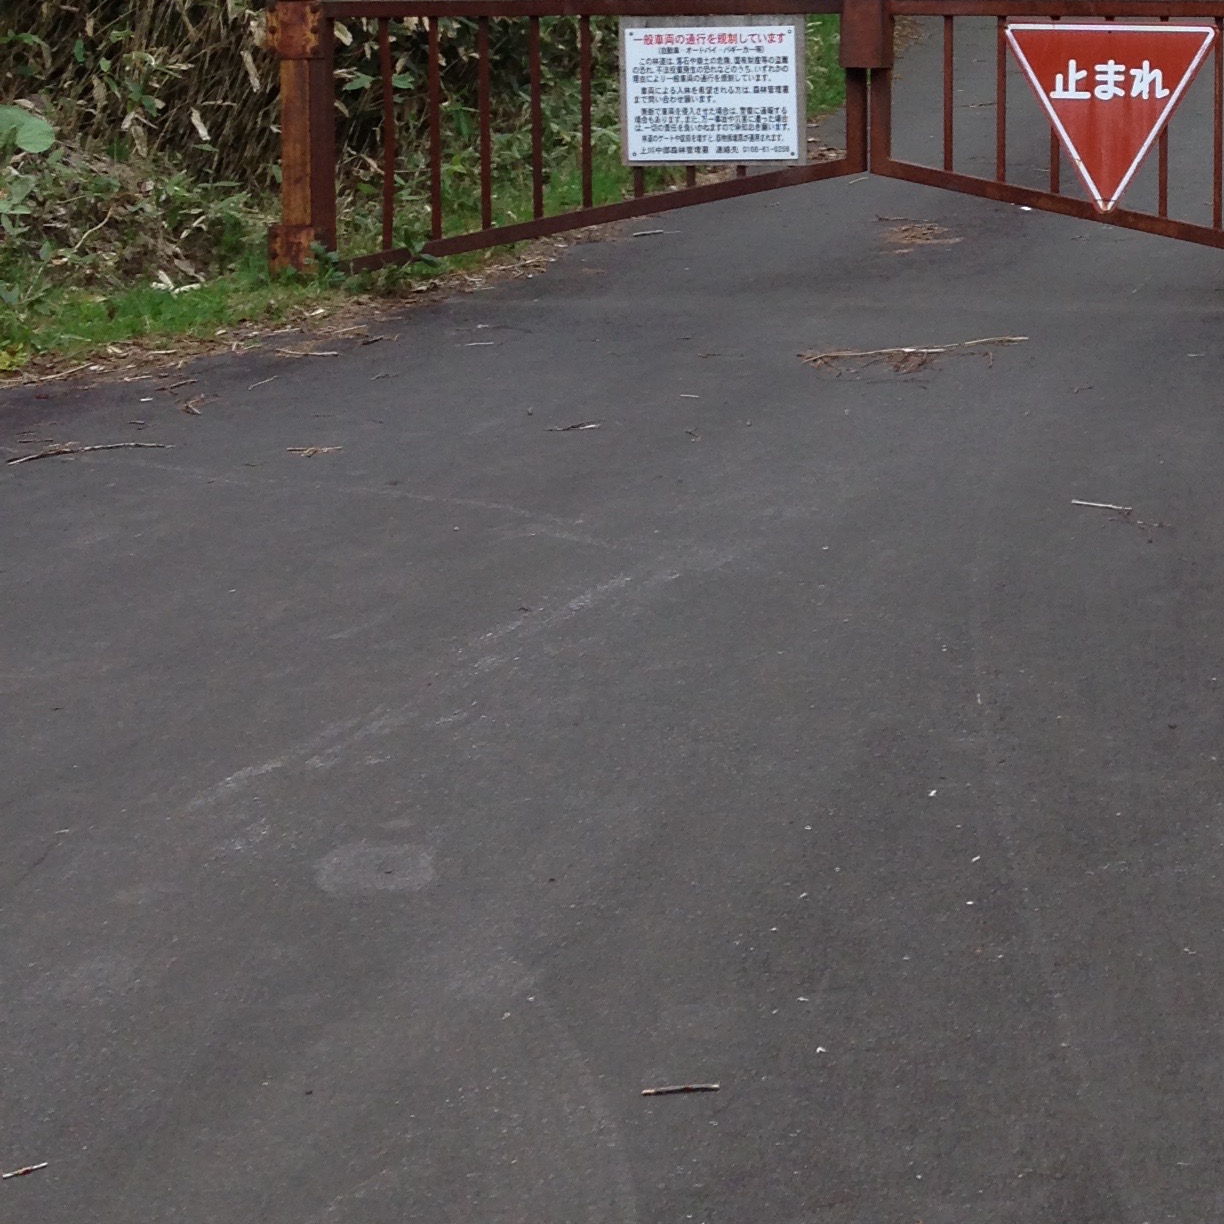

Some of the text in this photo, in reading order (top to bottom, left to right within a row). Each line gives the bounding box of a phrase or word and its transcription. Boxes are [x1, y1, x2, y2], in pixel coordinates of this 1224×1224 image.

[633, 33, 786, 45] 一般車両の通行を規制しています
[1050, 59, 1170, 100] 止まれ
